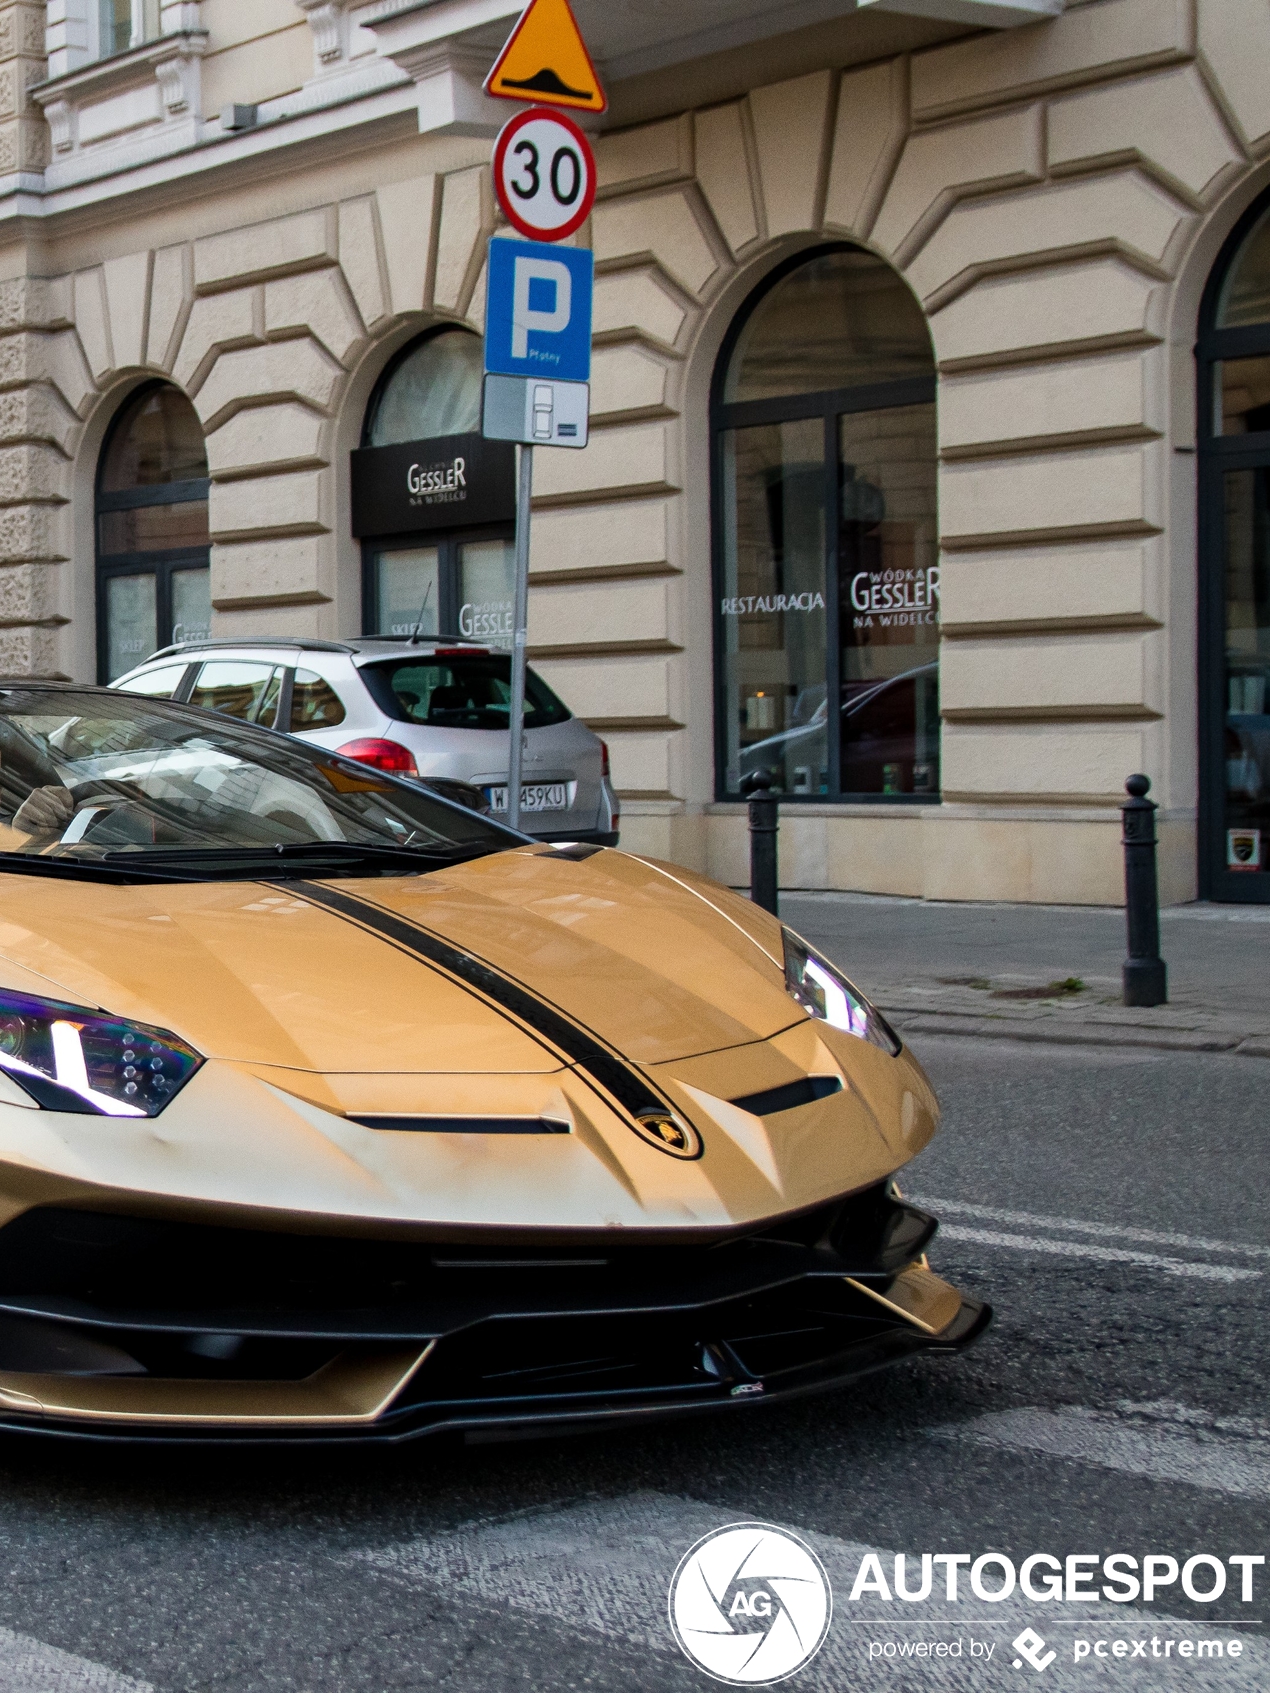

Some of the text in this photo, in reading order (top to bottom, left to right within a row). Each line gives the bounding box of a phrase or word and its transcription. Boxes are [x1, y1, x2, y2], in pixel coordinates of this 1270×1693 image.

[510, 140, 581, 206] 30
[511, 255, 572, 359] P
[407, 457, 466, 494] GESSLER
[721, 591, 825, 616] RESTAURACJA
[853, 616, 873, 629] NA
